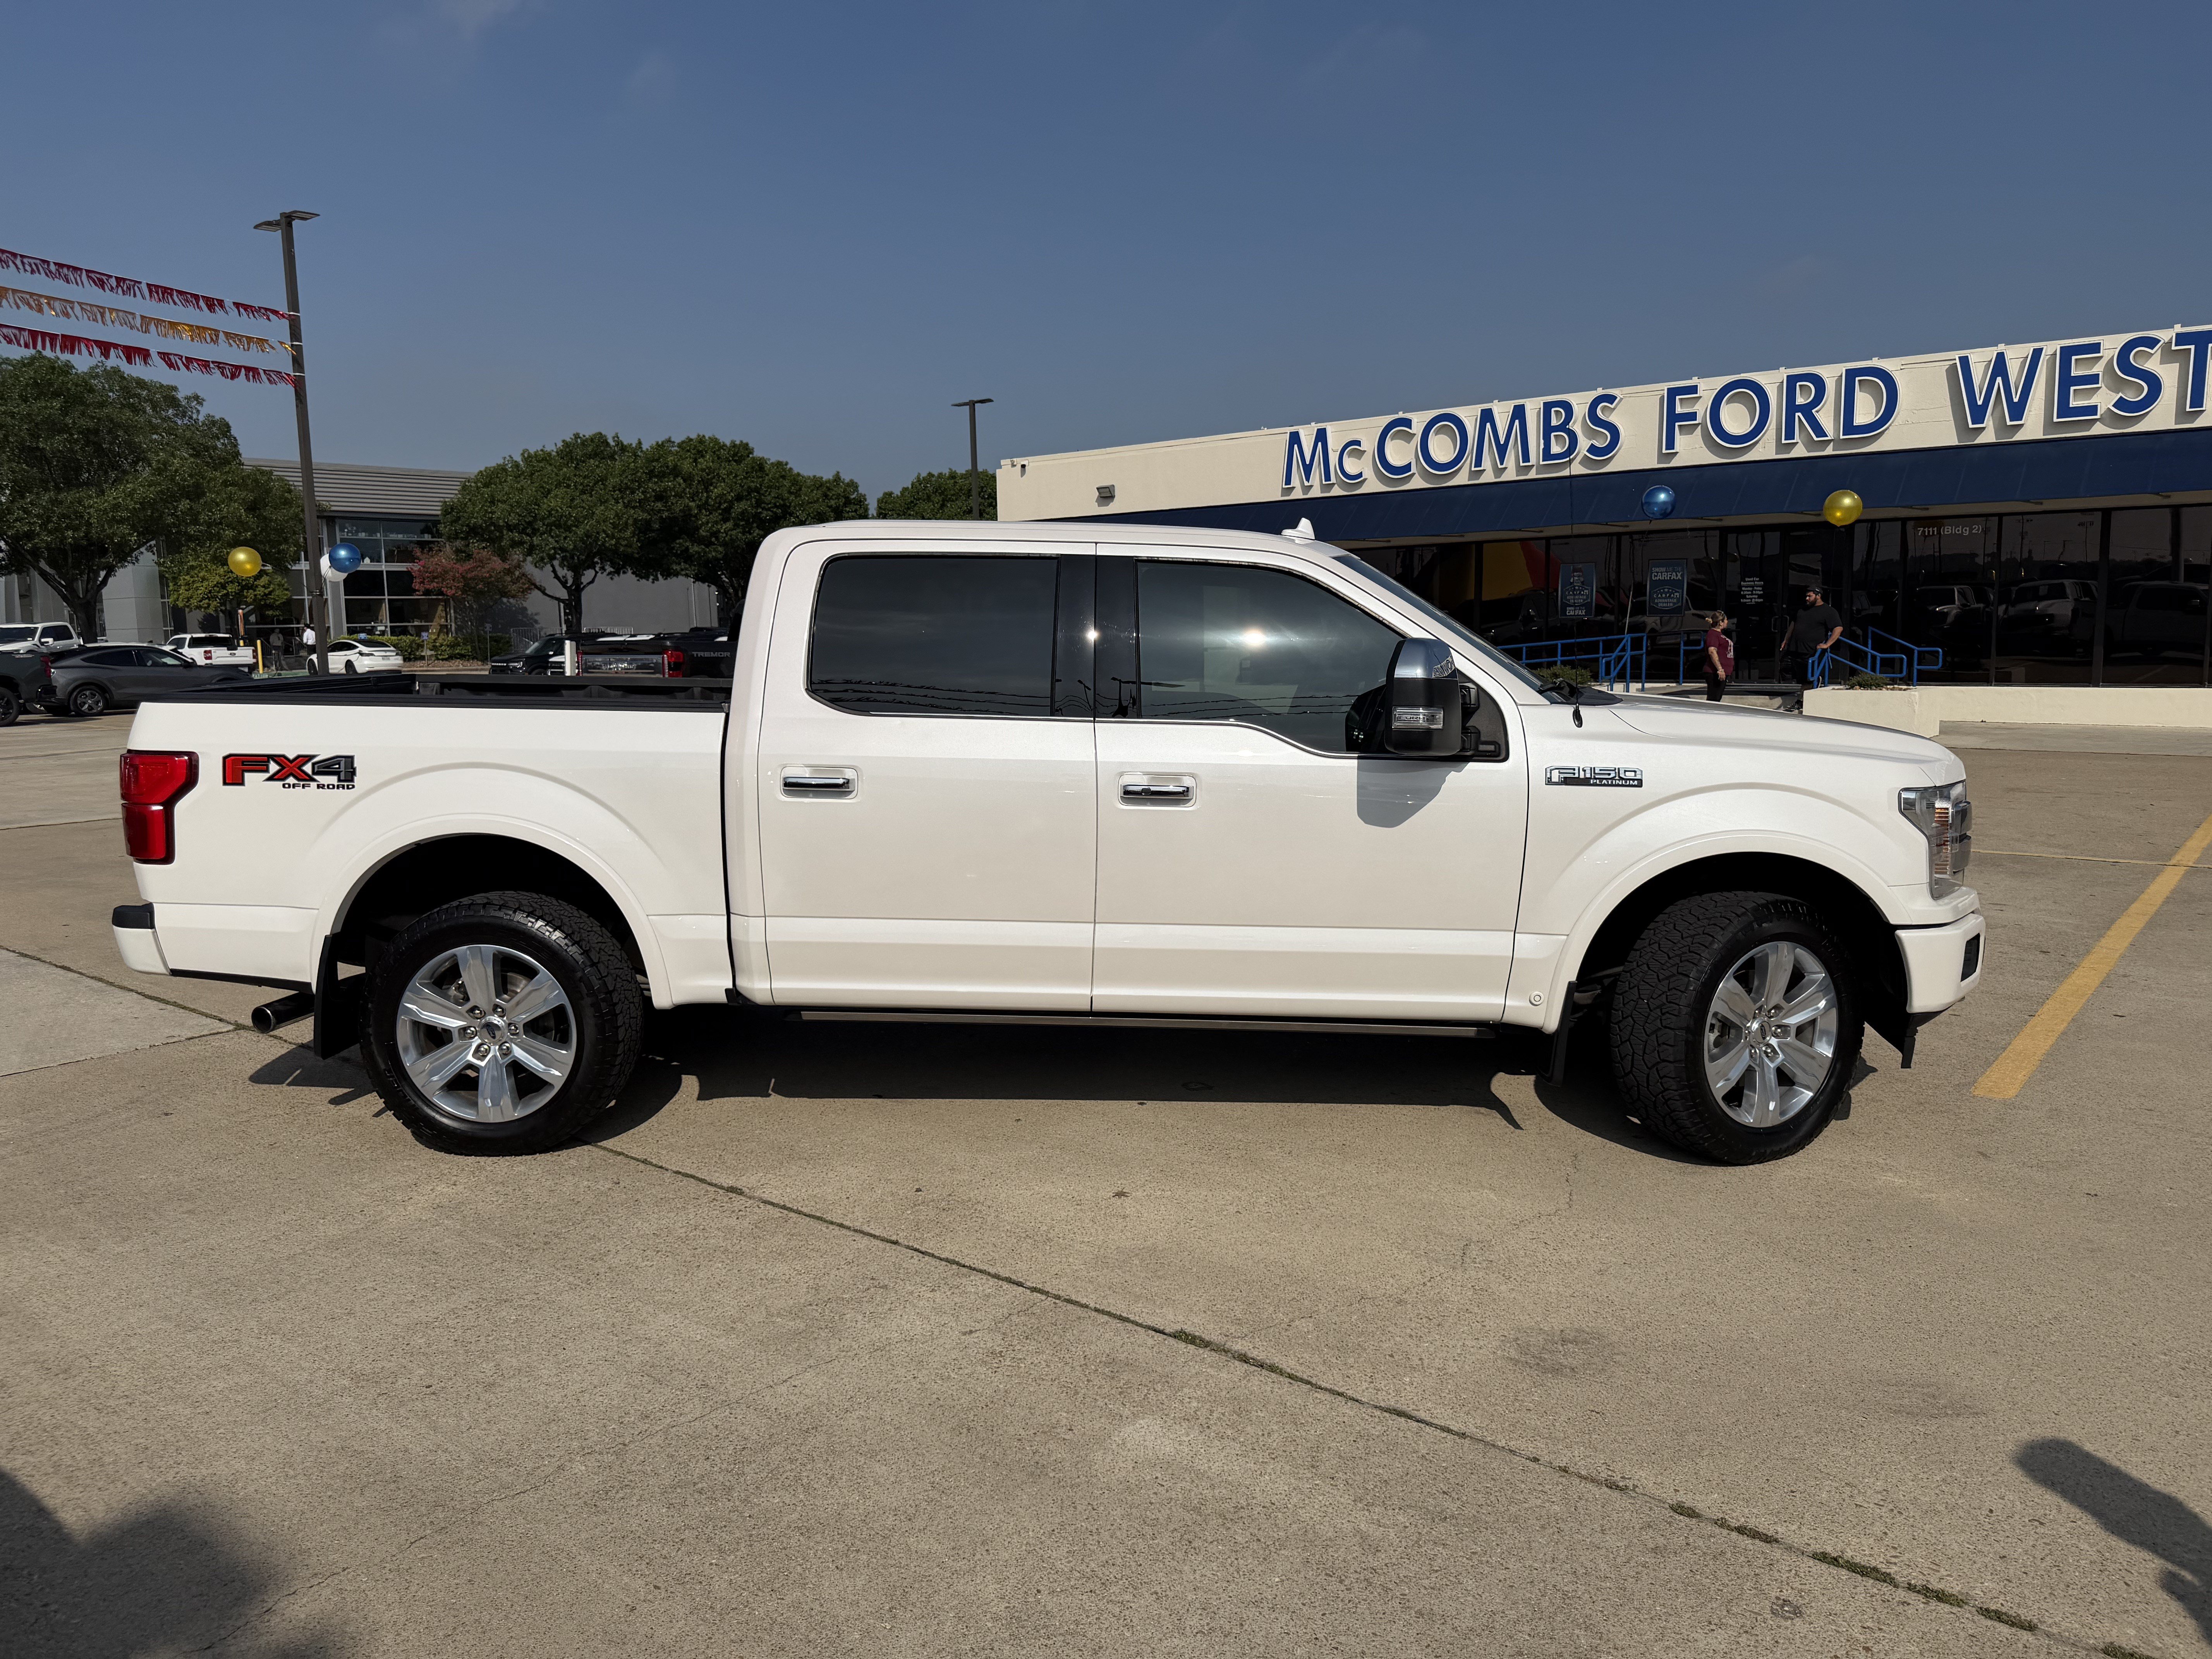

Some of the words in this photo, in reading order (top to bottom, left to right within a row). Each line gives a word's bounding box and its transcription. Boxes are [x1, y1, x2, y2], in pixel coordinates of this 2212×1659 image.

[1283, 392, 1623, 488] McCOMBS
[1662, 364, 1901, 454] FORD
[1955, 328, 2212, 429] WEST
[1917, 527, 1937, 536] 7111
[1941, 526, 1969, 536] (Bldg
[1972, 525, 1982, 533] 2)
[1652, 572, 1681, 580] CARFAX
[222, 753, 357, 786] FX4
